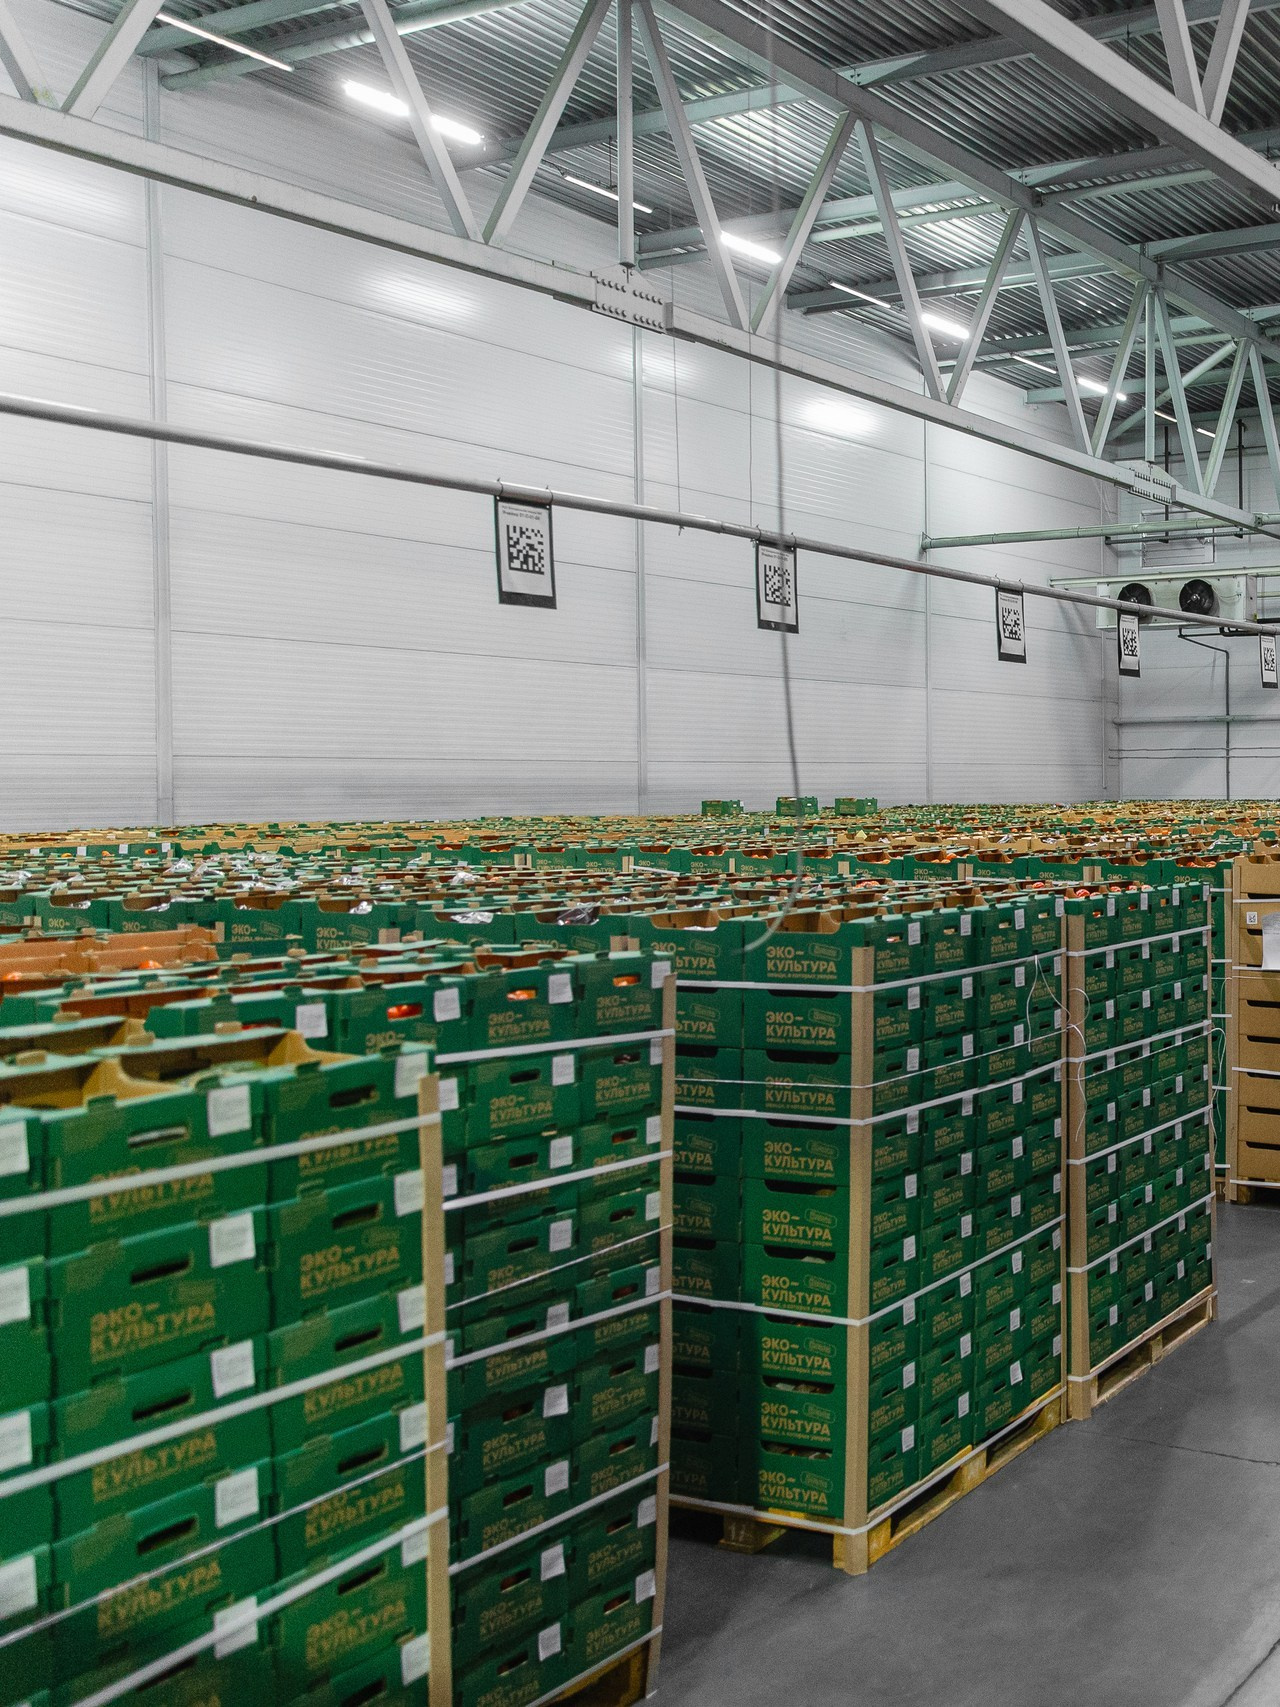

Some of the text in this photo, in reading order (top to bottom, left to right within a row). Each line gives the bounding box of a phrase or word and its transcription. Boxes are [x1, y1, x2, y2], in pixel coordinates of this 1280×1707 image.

[766, 946, 804, 958] ЭКО-
[676, 956, 716, 969] ЬТУРА
[767, 960, 837, 973] КУЛЬТУРА
[766, 1011, 803, 1024] ЭКО-
[675, 1021, 716, 1033] ЬТУРА
[766, 1026, 836, 1039] КУЛЬТУРА
[675, 1085, 715, 1097] ЬТУРА
[765, 1090, 835, 1105] КУЛЬТУРА
[764, 1141, 802, 1153] ЭКО-
[764, 1156, 834, 1171] КУЛЬТУРА
[763, 1209, 800, 1223] ЭКО-
[763, 1224, 831, 1240] КУЛЬТУРА
[762, 1275, 799, 1289] ЭКО-
[762, 1290, 831, 1307] КУЛЬТУРА
[762, 1337, 799, 1351] ЭКО-
[762, 1352, 831, 1368] КУЛЬТУРА
[761, 1402, 798, 1415] ЭКО-
[761, 1417, 831, 1436] КУЛЬТУРА
[759, 1470, 795, 1483] ЭКО-
[759, 1484, 828, 1503] КУЛЬТУРА
